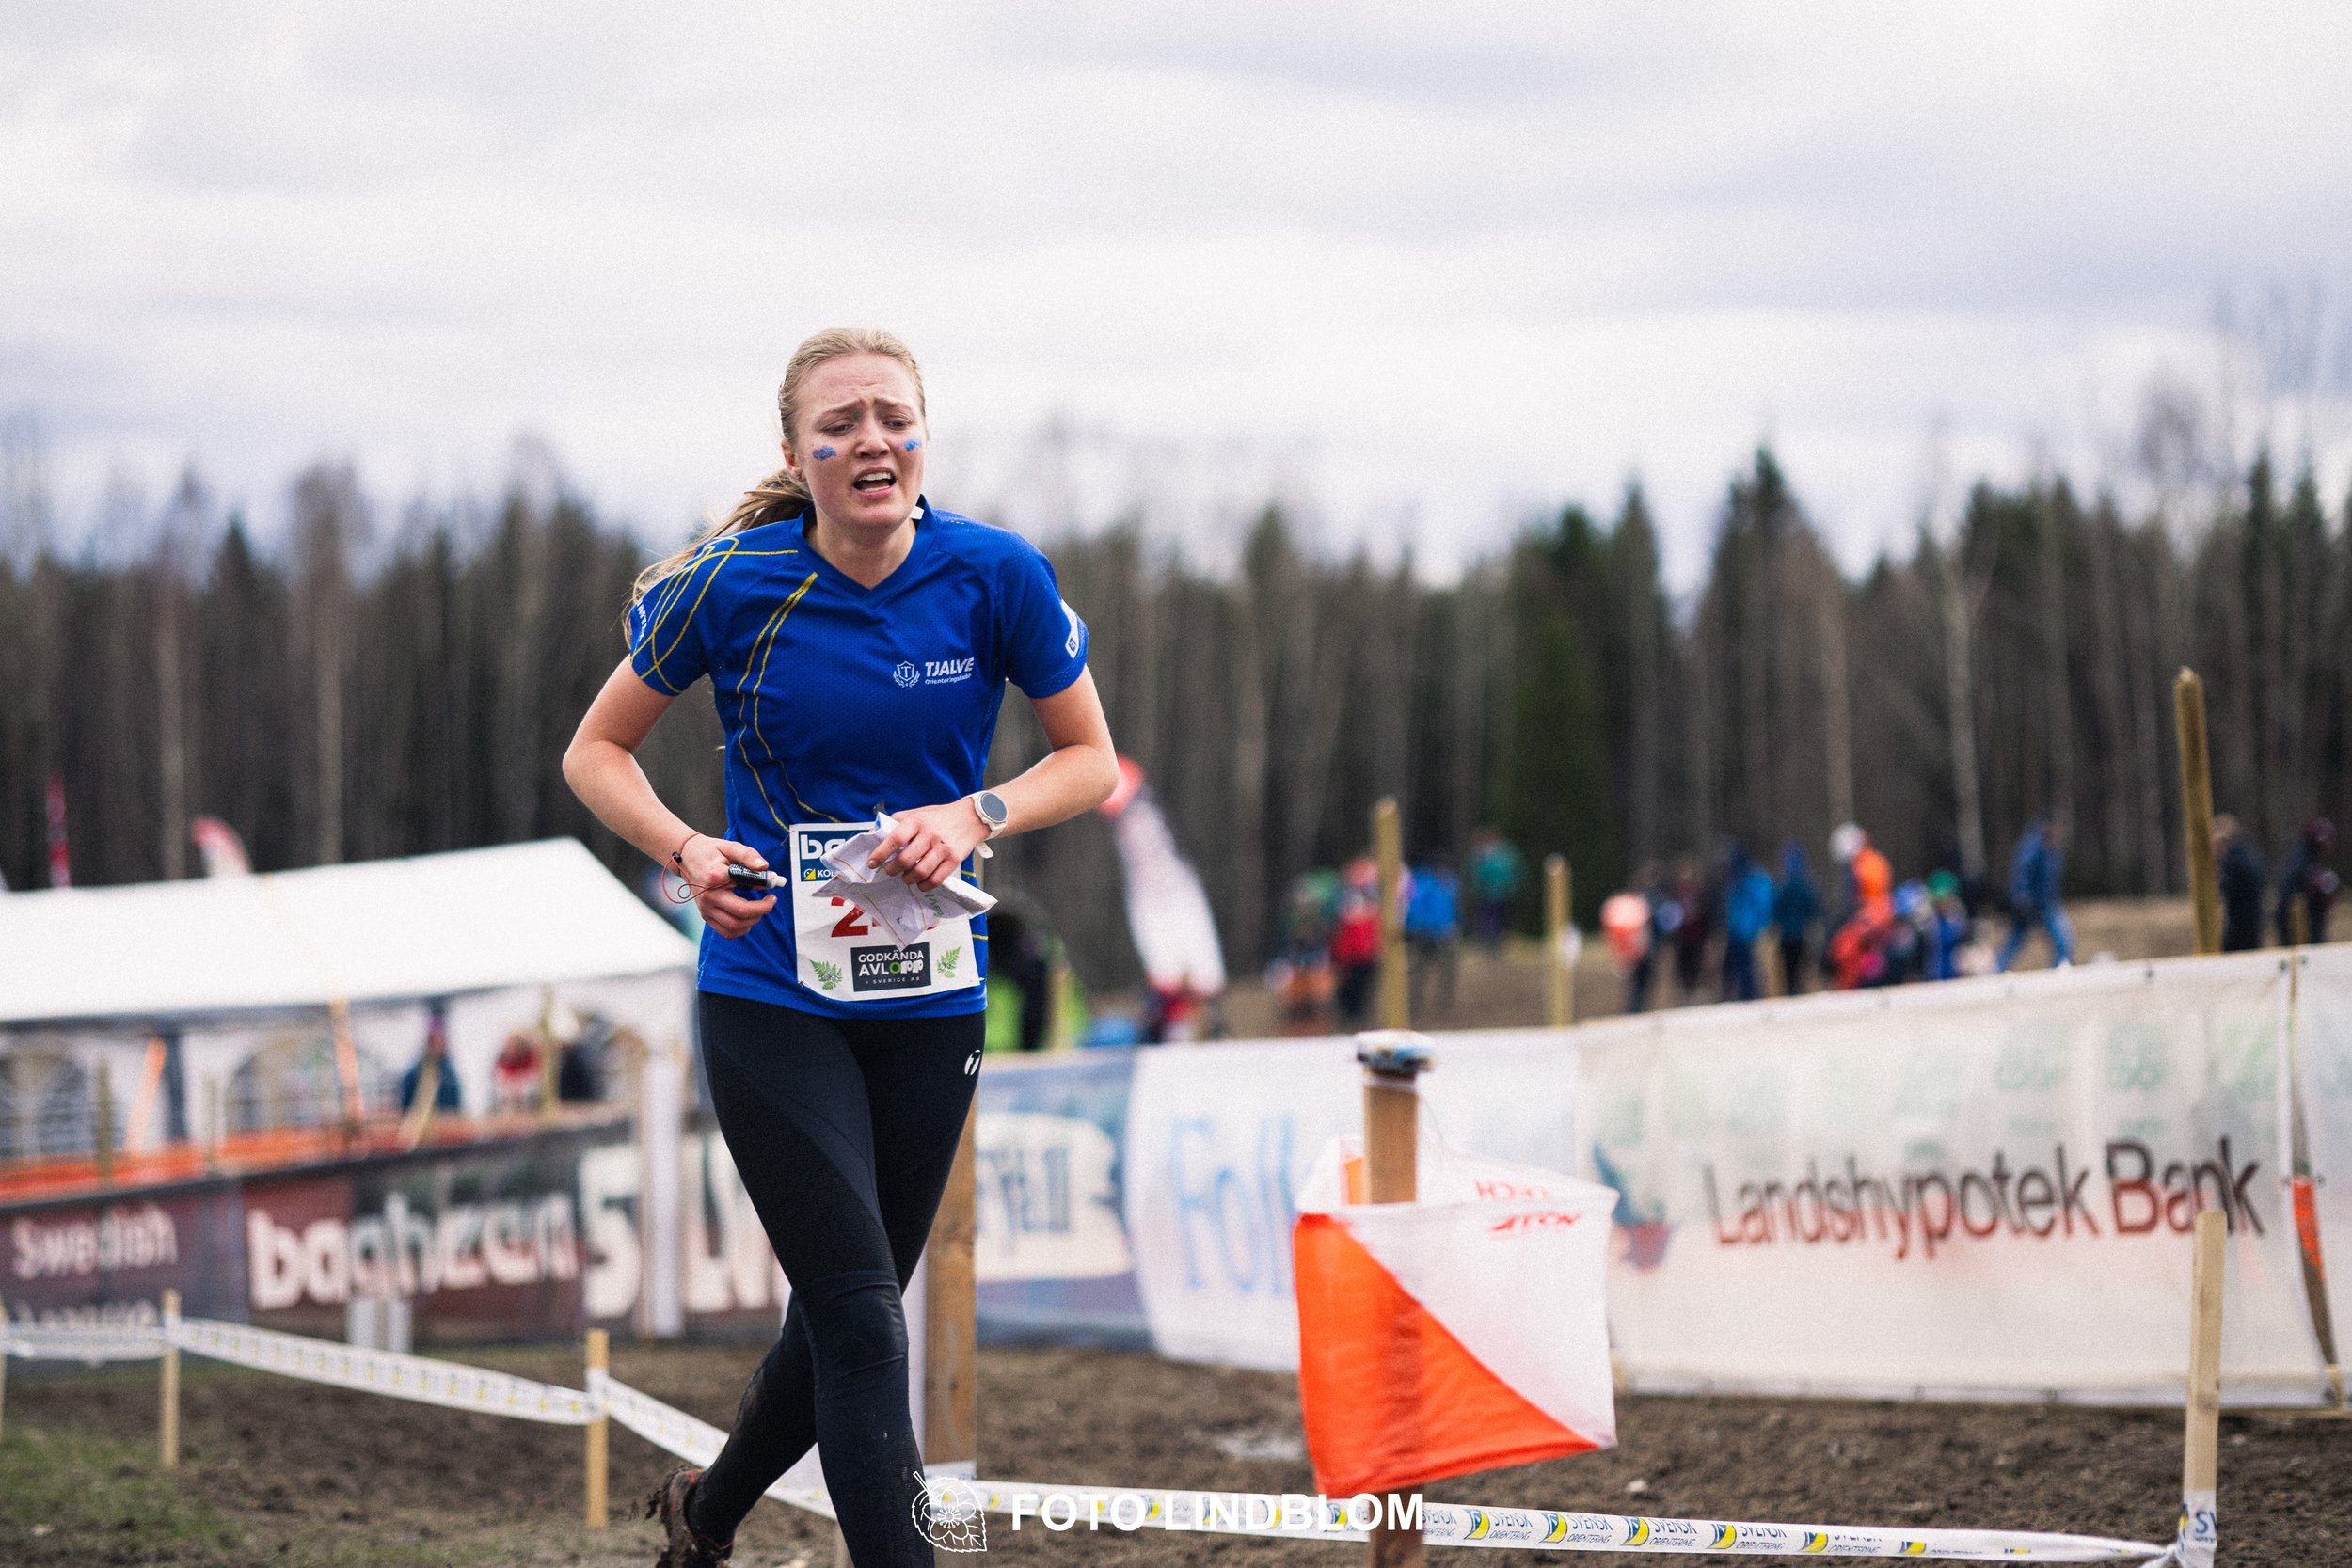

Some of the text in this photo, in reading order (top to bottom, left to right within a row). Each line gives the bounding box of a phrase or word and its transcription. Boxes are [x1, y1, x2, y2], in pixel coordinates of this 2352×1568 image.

[925, 657, 975, 677] TJALVE
[858, 949, 924, 963] GODKÄNDA
[858, 959, 924, 976] AVLOPP
[873, 976, 906, 985] SVERIGE
[1703, 1135, 2265, 1261] Landshypotek Bank
[1489, 1511, 1533, 1528] SVENSK
[1566, 1514, 1613, 1531] SVENSK
[1648, 1518, 1697, 1534] SVENSK
